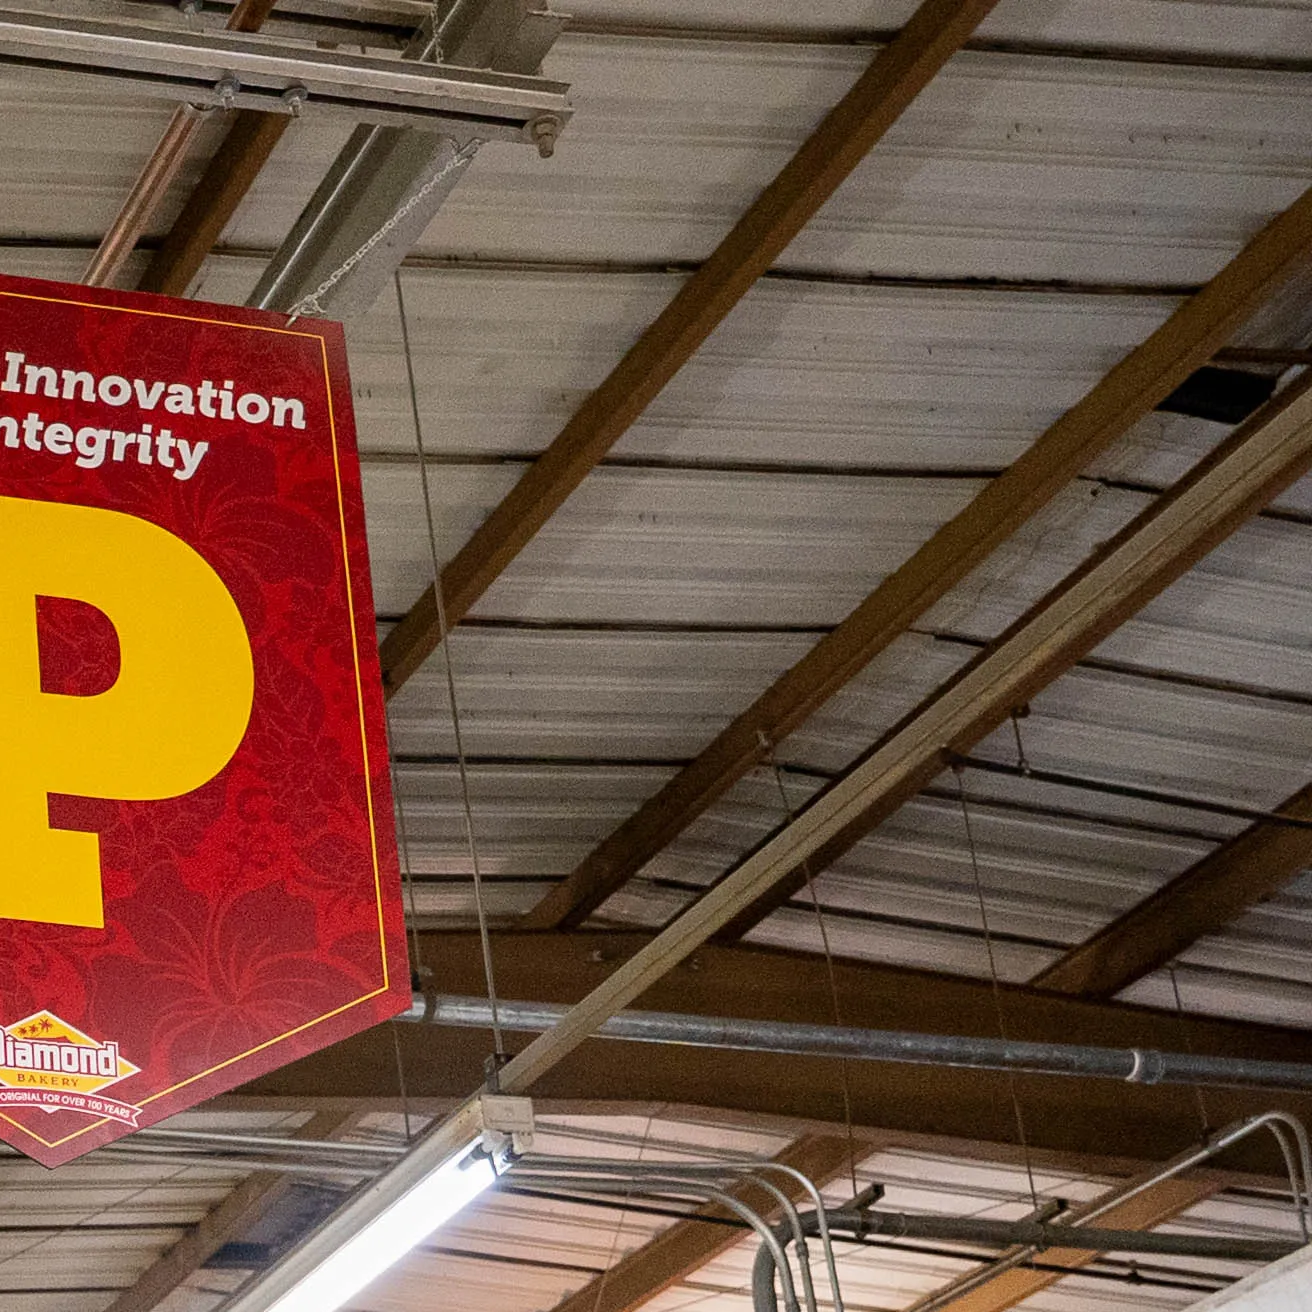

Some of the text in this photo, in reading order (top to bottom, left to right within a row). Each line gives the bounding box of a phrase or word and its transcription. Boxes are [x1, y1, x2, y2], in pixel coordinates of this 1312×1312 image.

[0, 351, 307, 430] Innovation
[17, 1073, 80, 1088] BAKERY
[0, 1092, 41, 1102] ORIGINAL
[42, 1093, 60, 1103] FOR
[61, 1096, 85, 1107] OVER
[87, 1100, 102, 1111] 100
[103, 1103, 131, 1118] YEARS
